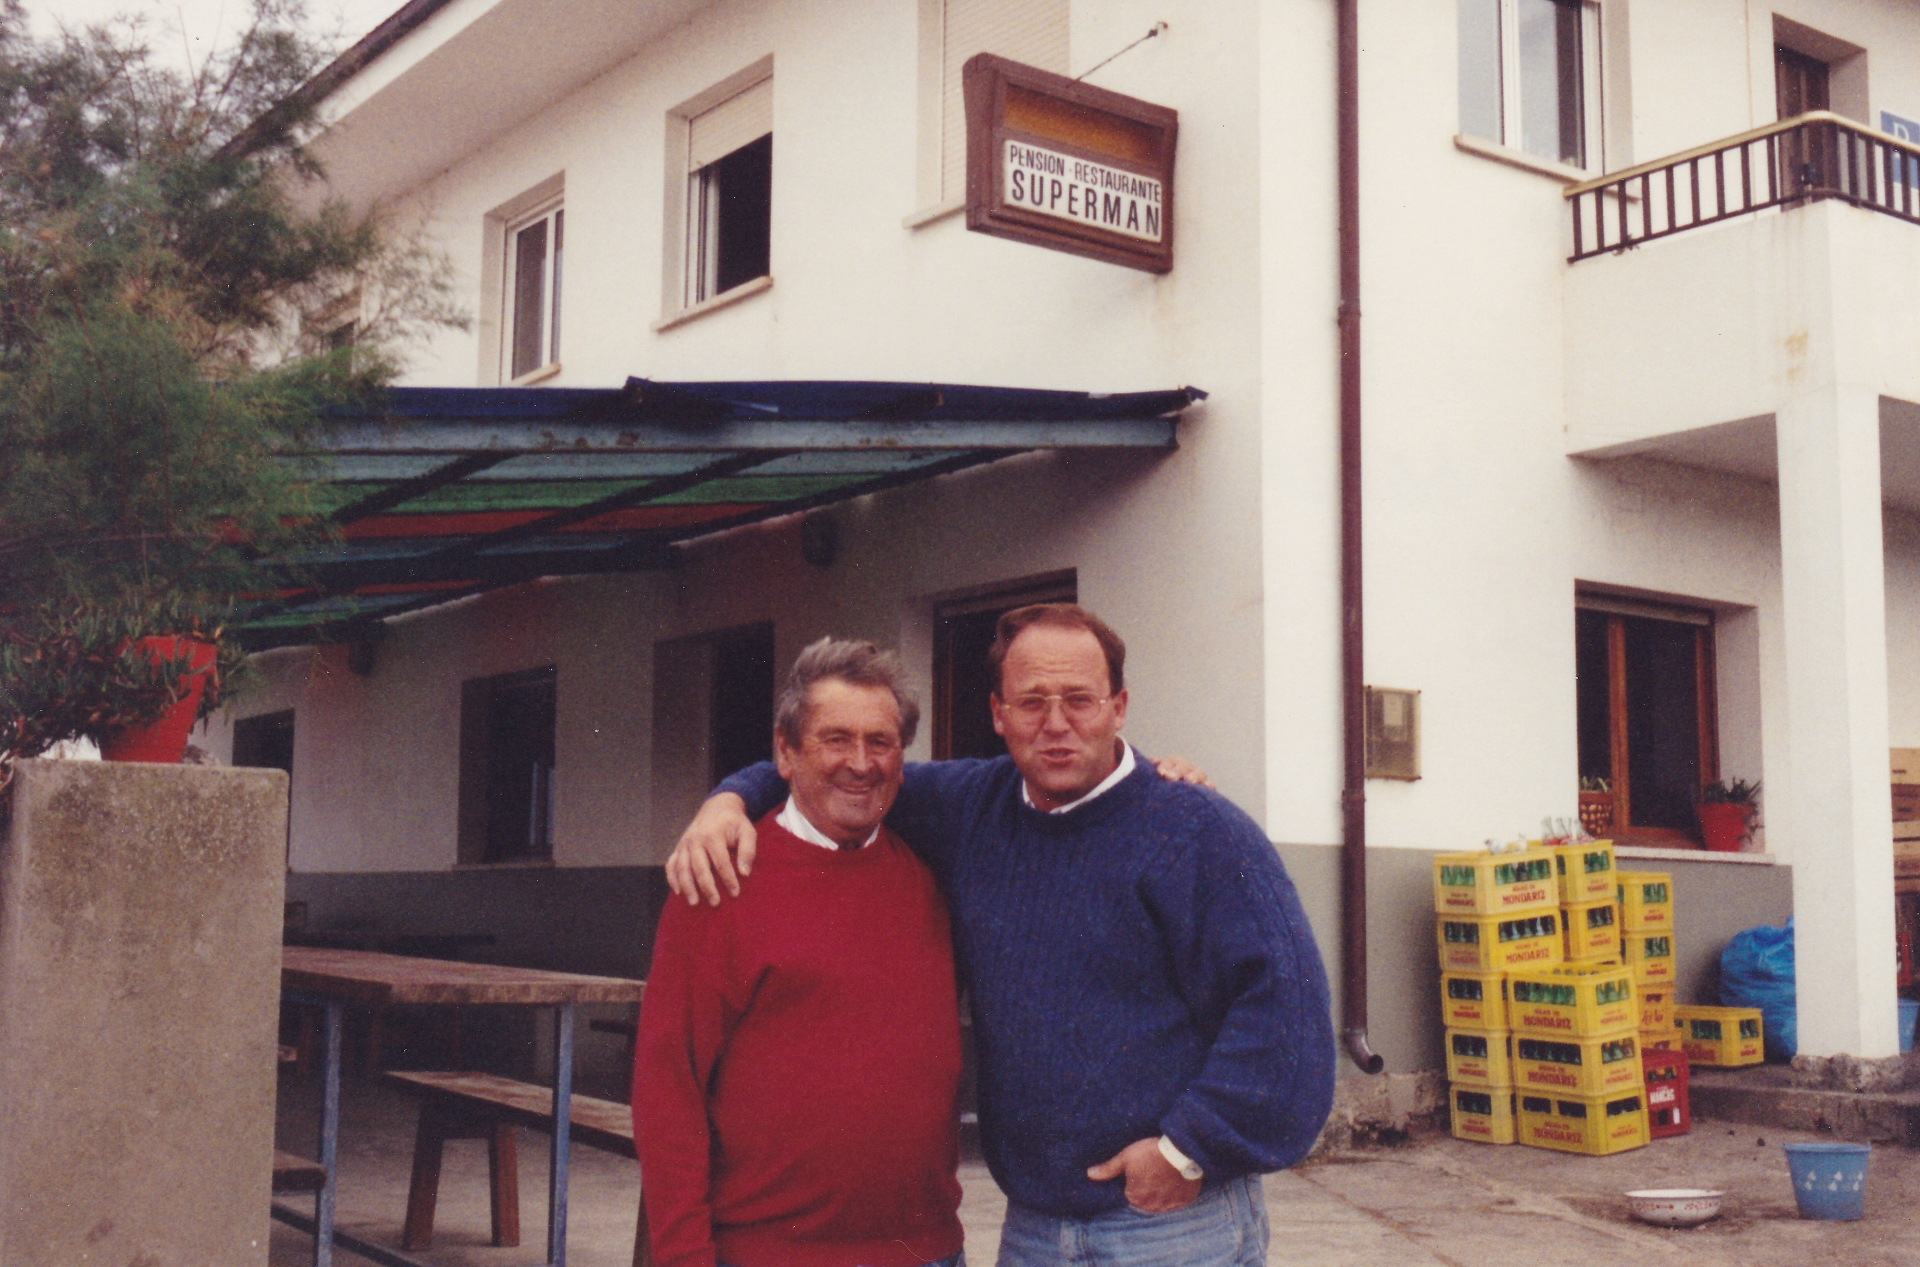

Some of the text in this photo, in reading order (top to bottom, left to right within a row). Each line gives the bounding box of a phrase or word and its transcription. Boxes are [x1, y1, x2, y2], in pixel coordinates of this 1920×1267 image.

[1010, 144, 1161, 203] PENSION RESTAURANTE
[1012, 169, 1159, 236] SUPERMAN
[1502, 889, 1546, 905] MONDARIZ
[1506, 948, 1550, 964] MONDARIZ
[1523, 1015, 1572, 1030] MONDARIZ
[1528, 1071, 1577, 1088] MONDARIZ
[1533, 1127, 1583, 1144] MONDARIZ
